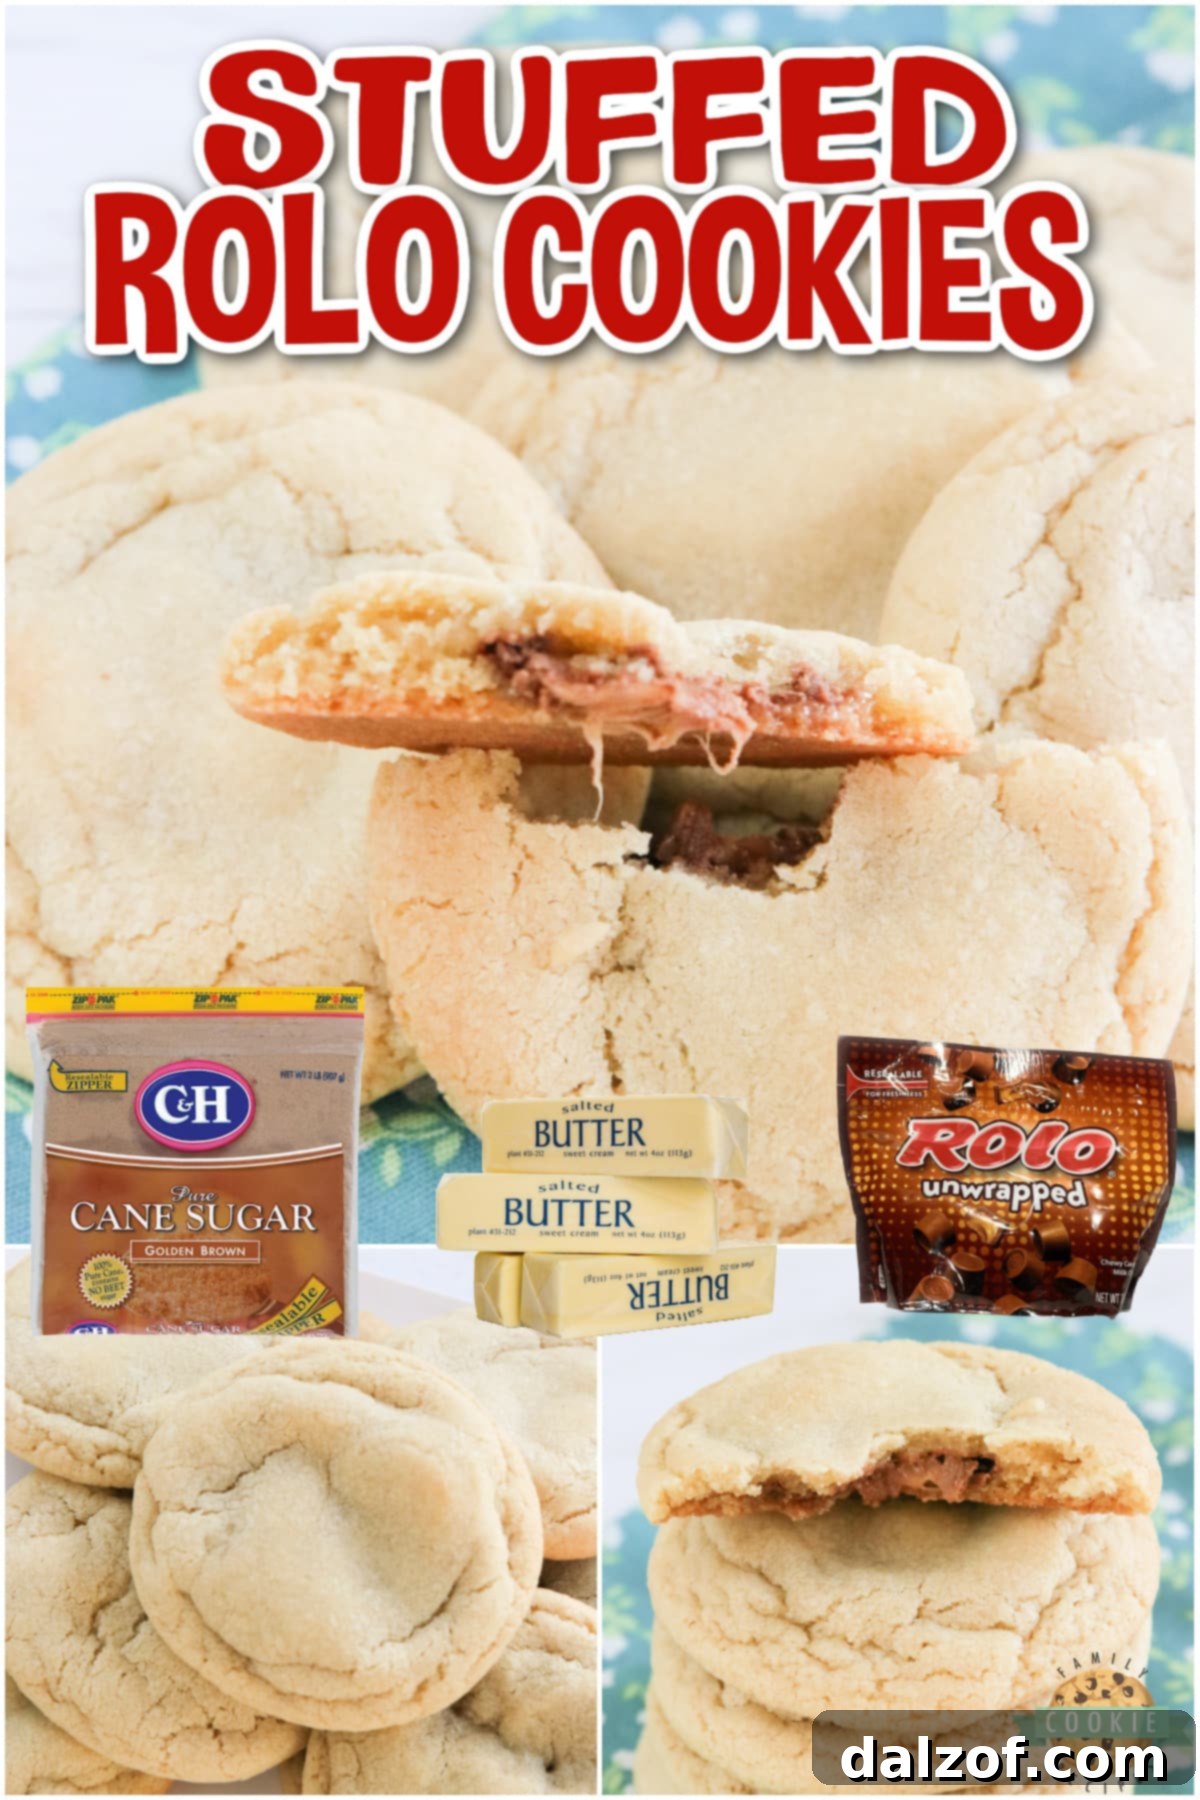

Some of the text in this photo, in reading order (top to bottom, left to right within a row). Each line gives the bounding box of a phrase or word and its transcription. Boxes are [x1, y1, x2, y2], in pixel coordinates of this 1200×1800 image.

[66, 1080, 113, 1090] ZIPPER
[153, 1084, 232, 1124] C&H
[561, 1100, 615, 1115] salted
[534, 1117, 647, 1148] BUTTER
[563, 1150, 586, 1158] sweet
[589, 1150, 615, 1158] cream
[170, 1185, 216, 1202] Pure
[538, 1179, 600, 1194] salted
[922, 1178, 1088, 1212] unwrapped
[70, 1201, 318, 1232] CANE SUGAR
[503, 1197, 635, 1228] BUTTER
[539, 1229, 566, 1237] sweet
[569, 1229, 599, 1238] cream
[144, 1244, 246, 1257] GOLDEN BROWN
[626, 1272, 730, 1311] BUTTER
[655, 1306, 703, 1322] salted
